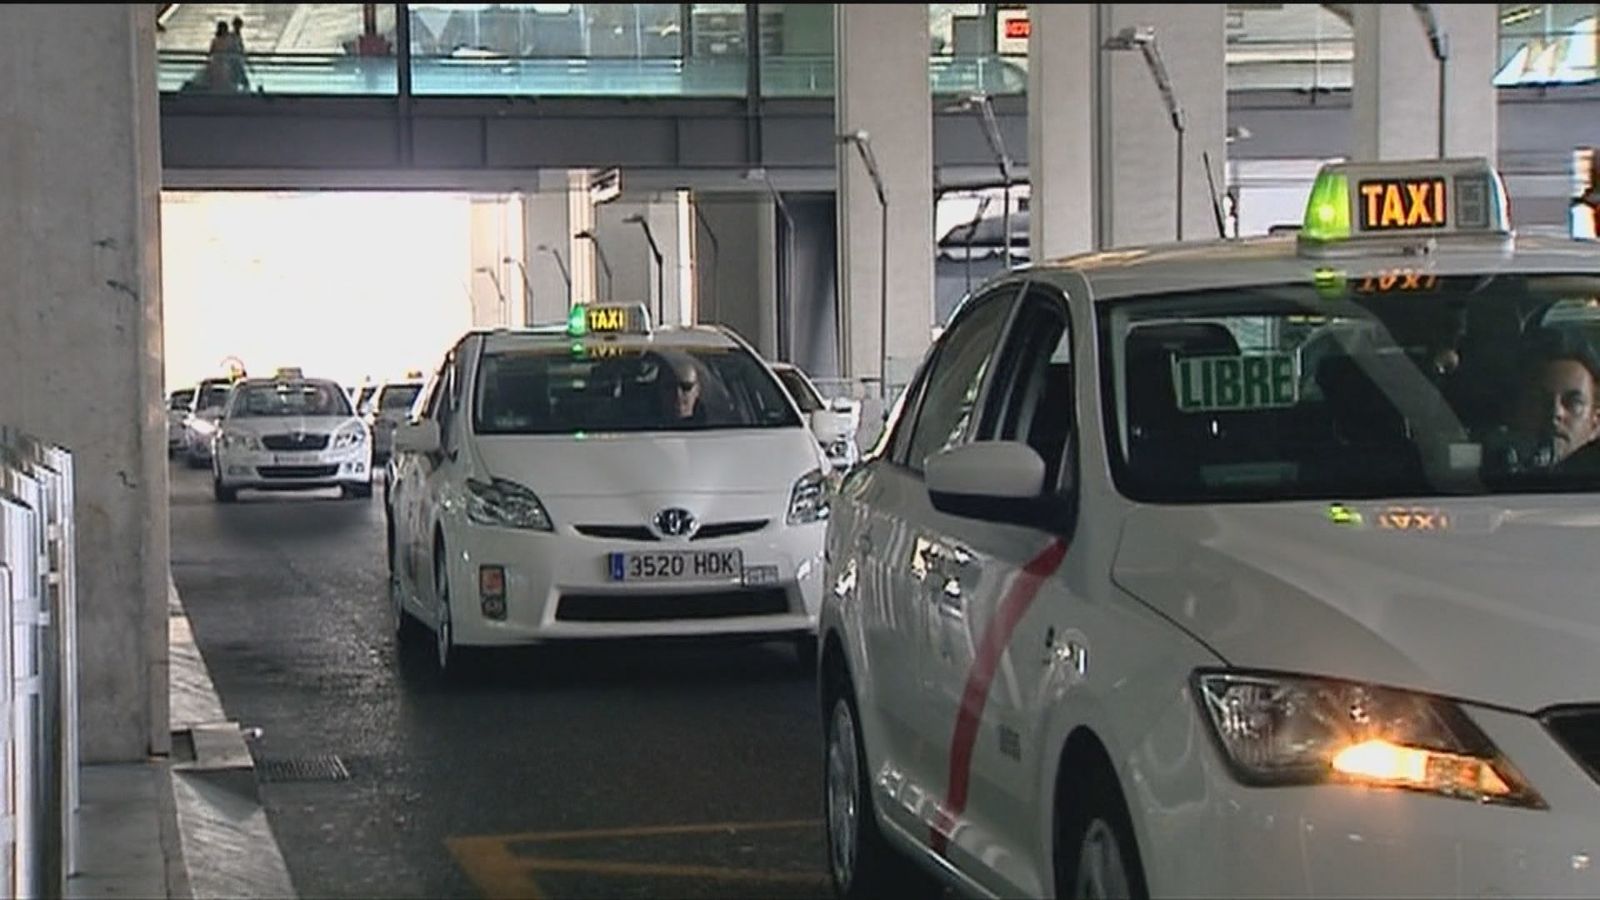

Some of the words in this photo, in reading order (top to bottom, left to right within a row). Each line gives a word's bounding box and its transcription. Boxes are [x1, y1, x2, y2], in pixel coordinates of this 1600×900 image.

[1361, 181, 1444, 227] TAXI
[590, 309, 624, 329] TAXI
[1181, 357, 1292, 408] LIBRE
[630, 555, 685, 577] 3520
